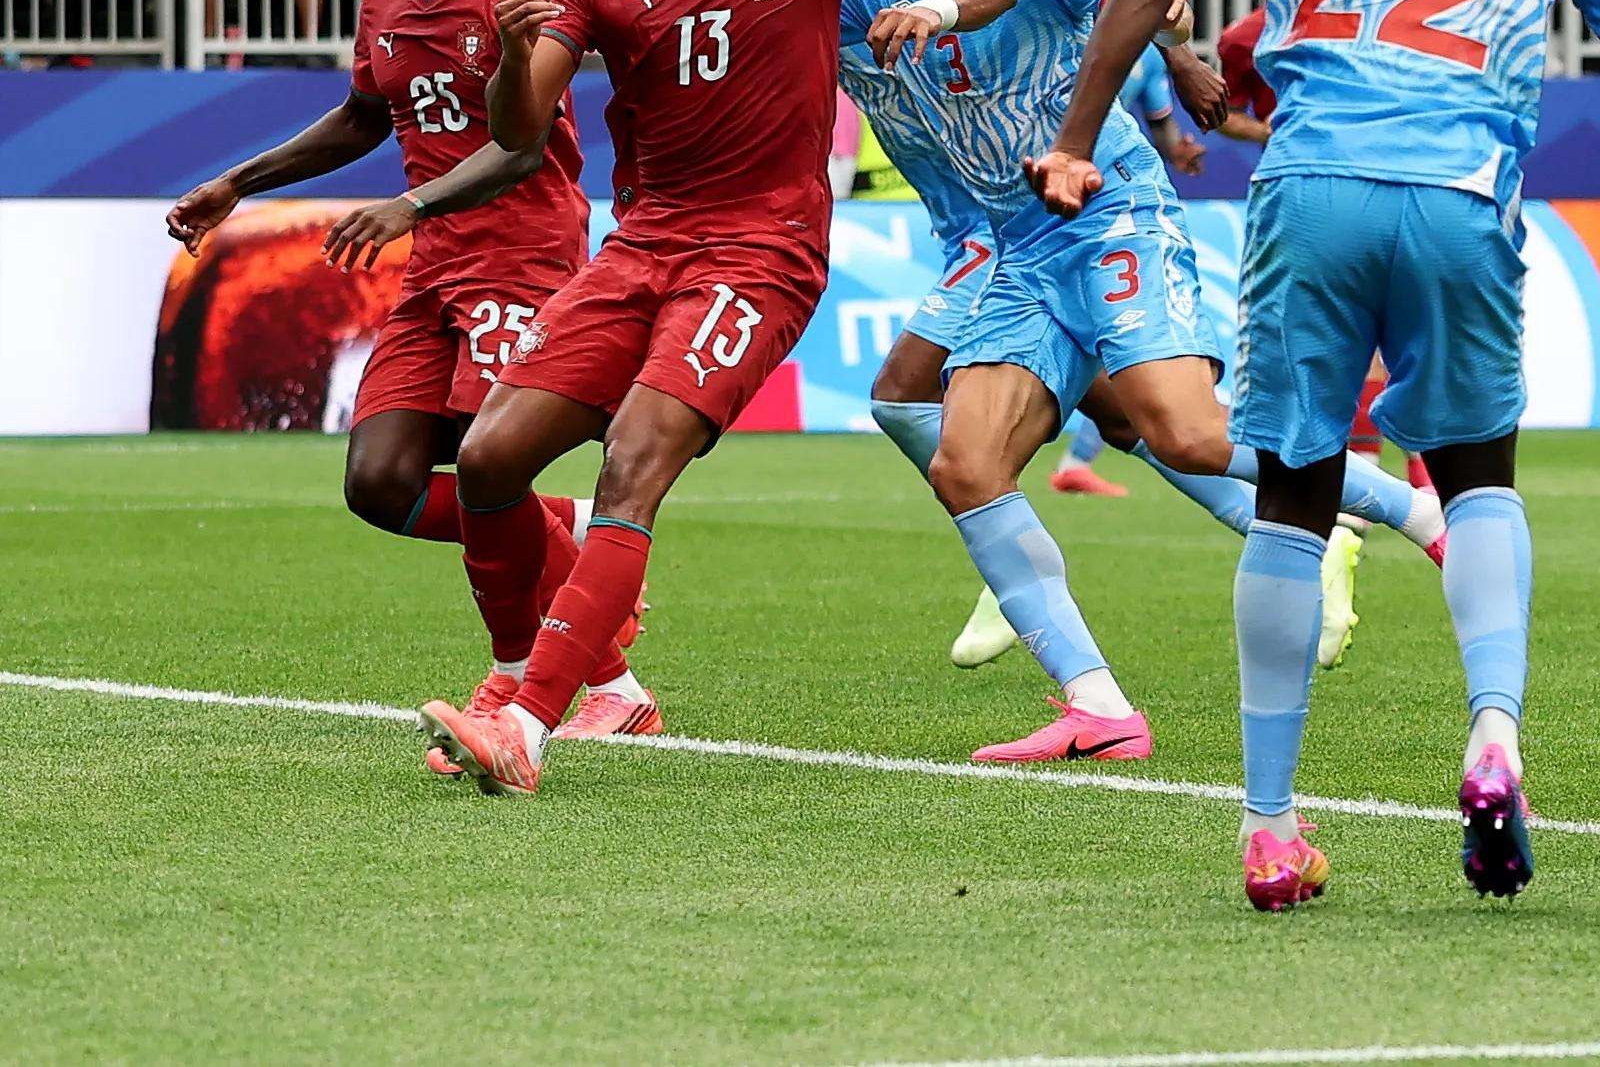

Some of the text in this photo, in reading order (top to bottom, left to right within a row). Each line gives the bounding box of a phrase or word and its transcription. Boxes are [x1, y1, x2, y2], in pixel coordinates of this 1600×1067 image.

[674, 9, 733, 86] 13
[934, 33, 973, 93] 3
[409, 72, 469, 133] 25
[942, 240, 993, 288] 7
[1100, 249, 1141, 303] 3
[469, 299, 535, 366] 25
[698, 284, 763, 367] 13
